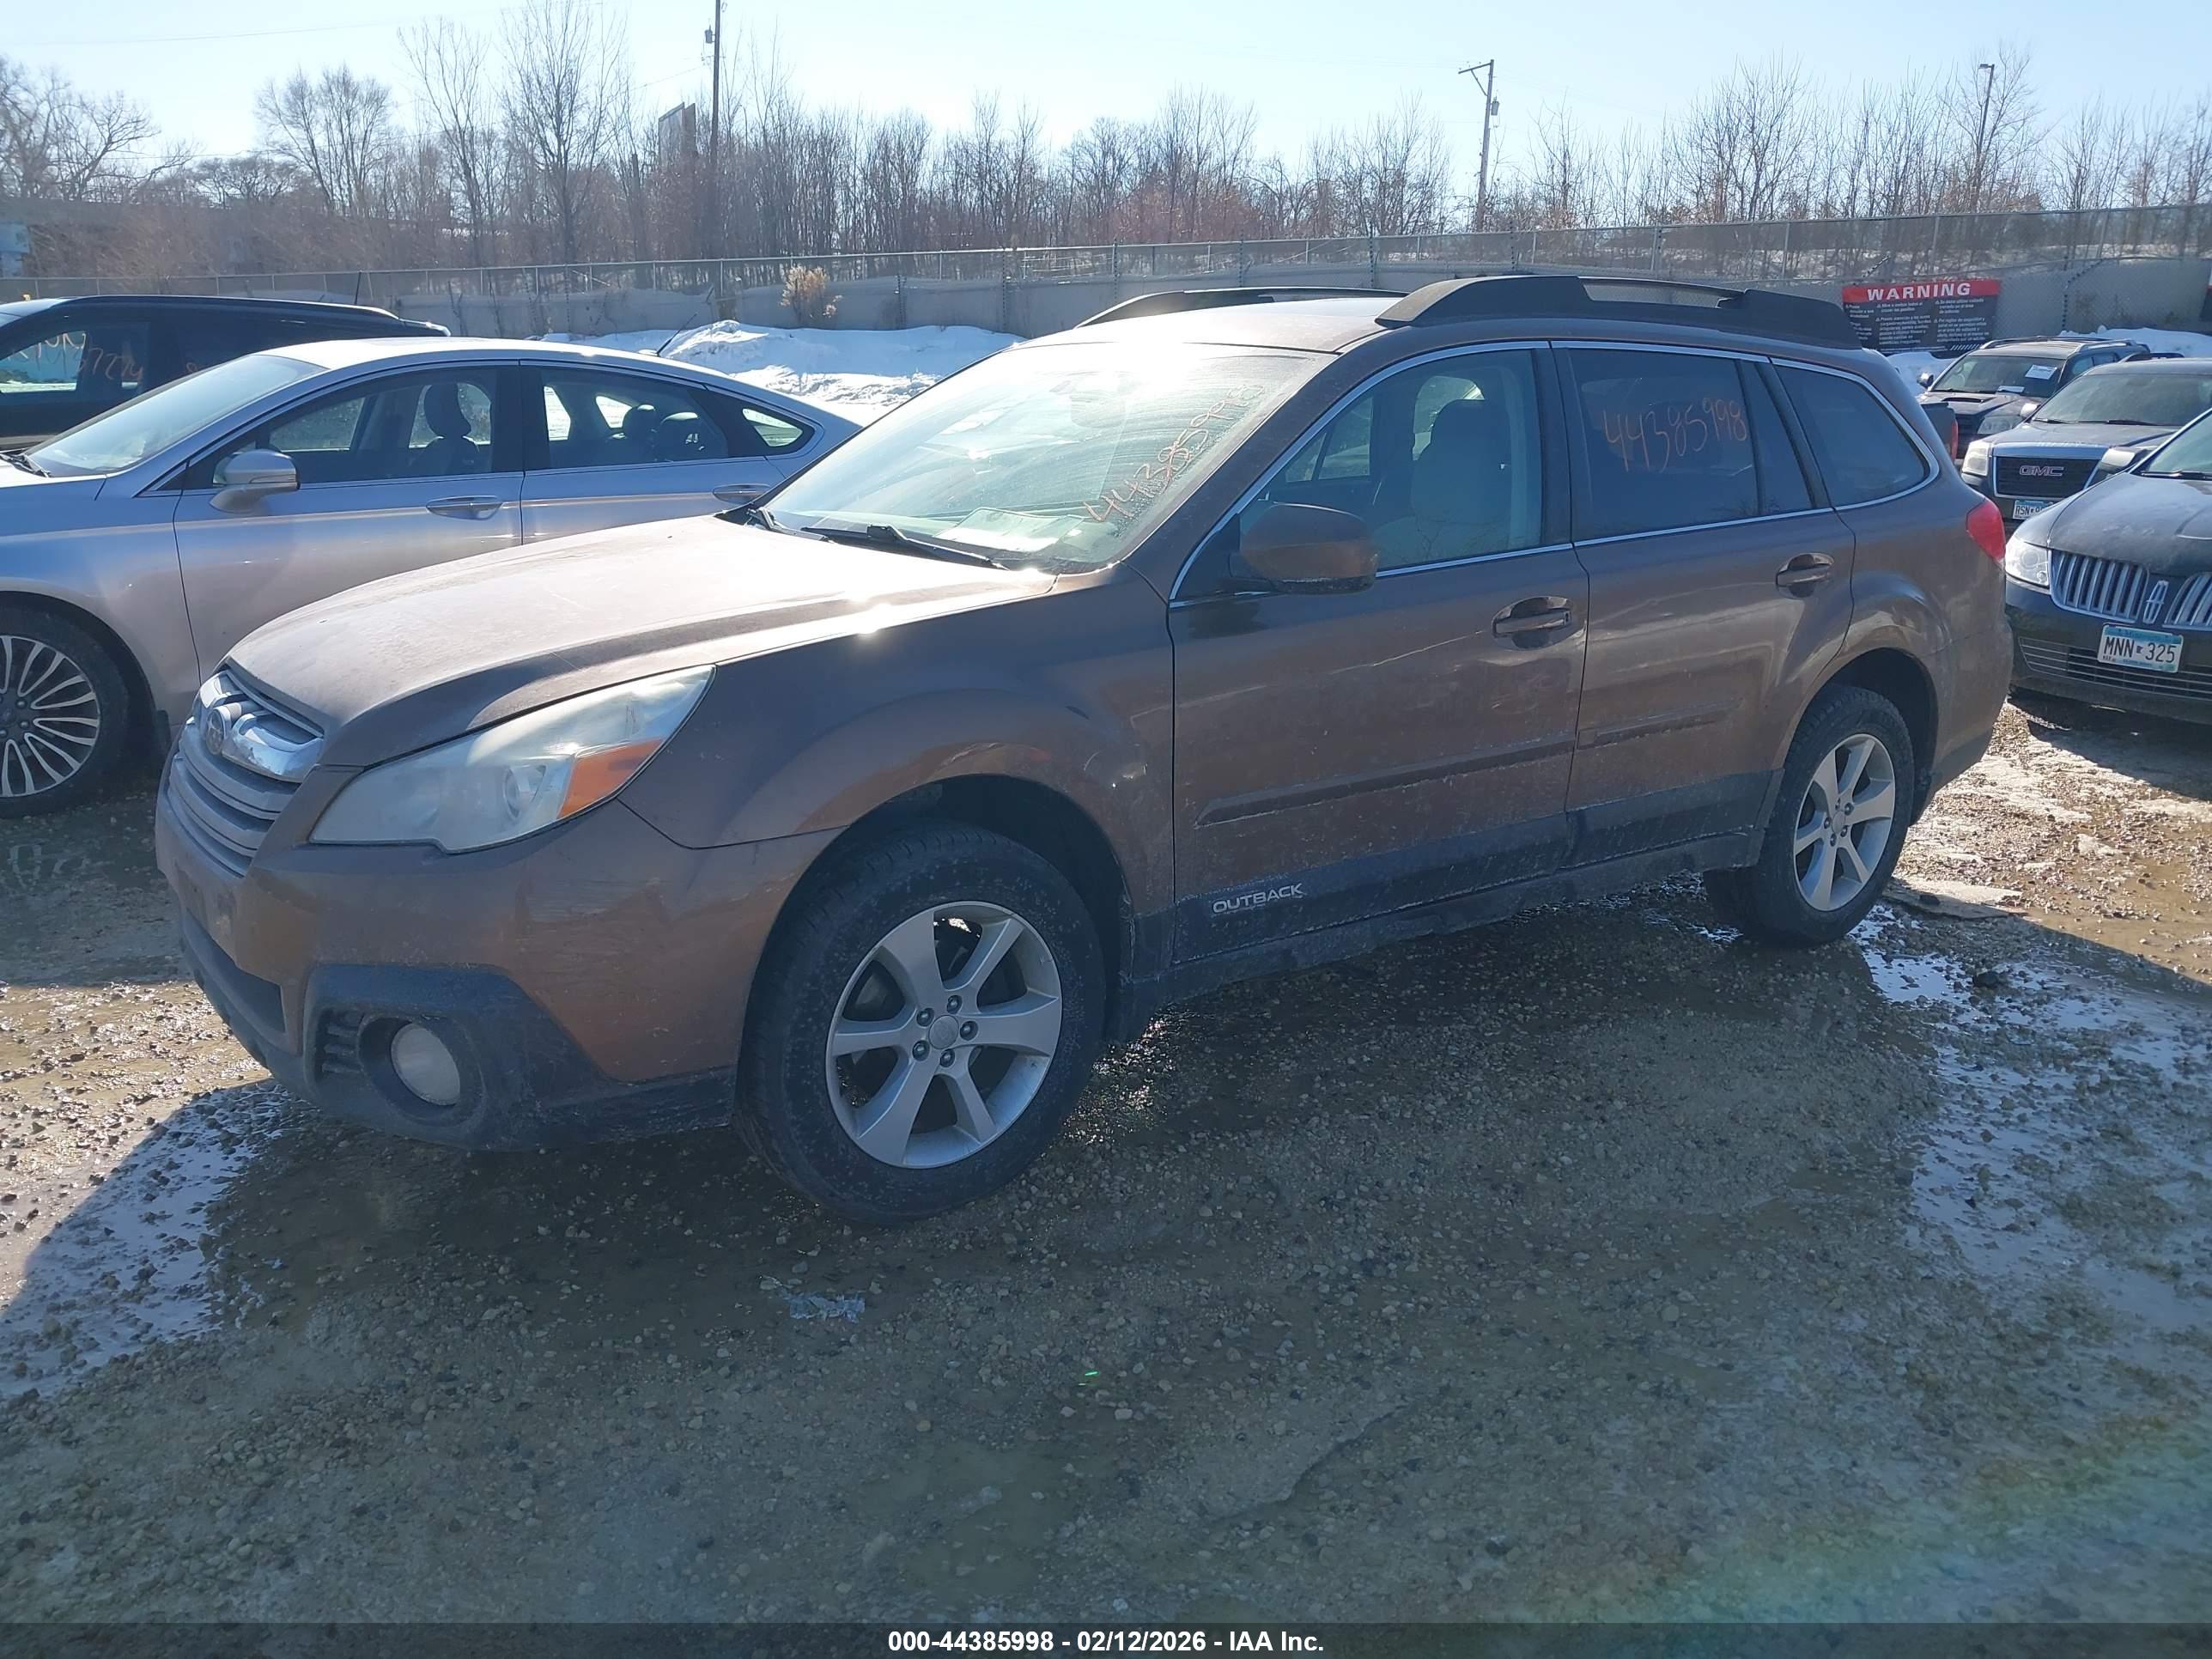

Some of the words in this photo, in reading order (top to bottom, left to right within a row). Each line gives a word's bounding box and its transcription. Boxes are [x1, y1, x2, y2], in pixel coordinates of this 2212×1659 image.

[1867, 282, 1972, 301] WARNING
[1602, 398, 1747, 472] 44385998
[2020, 465, 2064, 477] GMC
[2015, 505, 2030, 516] RSN
[2104, 636, 2135, 658] MNN
[2145, 642, 2177, 663] 325
[1212, 883, 1307, 914] OUTBACK
